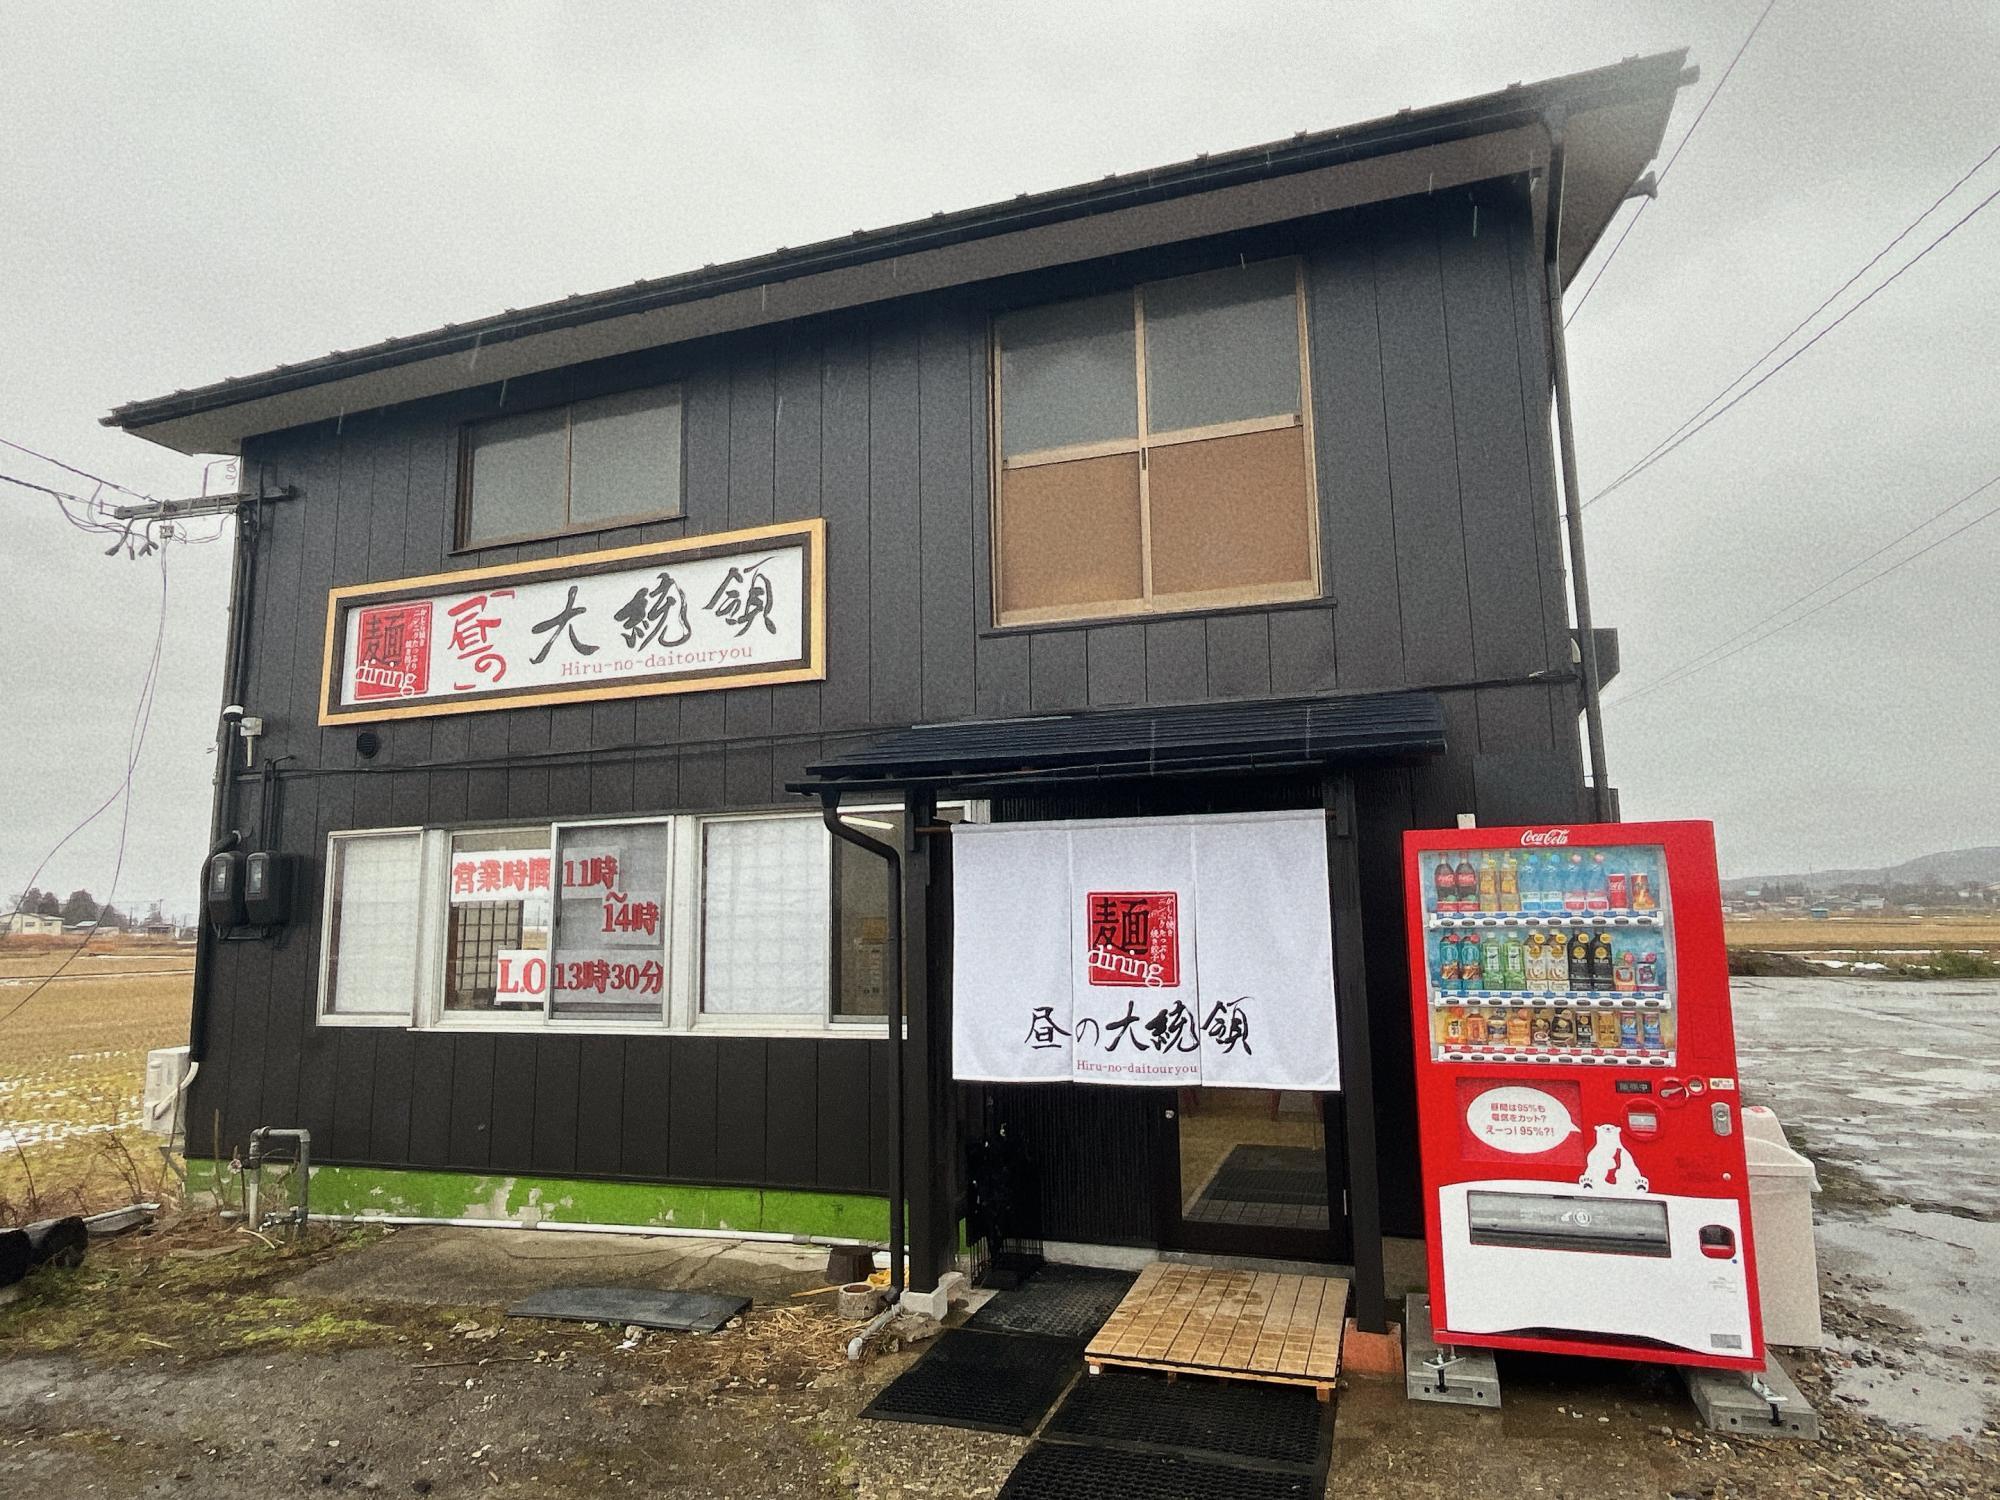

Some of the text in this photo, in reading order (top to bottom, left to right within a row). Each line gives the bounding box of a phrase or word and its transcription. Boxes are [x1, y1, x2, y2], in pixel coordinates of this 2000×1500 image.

[529, 556, 779, 665] 大統領
[355, 659, 417, 697] dining
[561, 646, 752, 677] Hiru-no-daitouryou
[453, 855, 619, 894] 営業時間 11時
[602, 901, 660, 936] 14時
[1092, 896, 1150, 955] 麺
[498, 957, 664, 995] L.O 13時30分
[1087, 943, 1164, 988] dining
[1024, 996, 1255, 1056] 昼の大統領
[1077, 1059, 1197, 1076] Hiru-no-daitouryou
